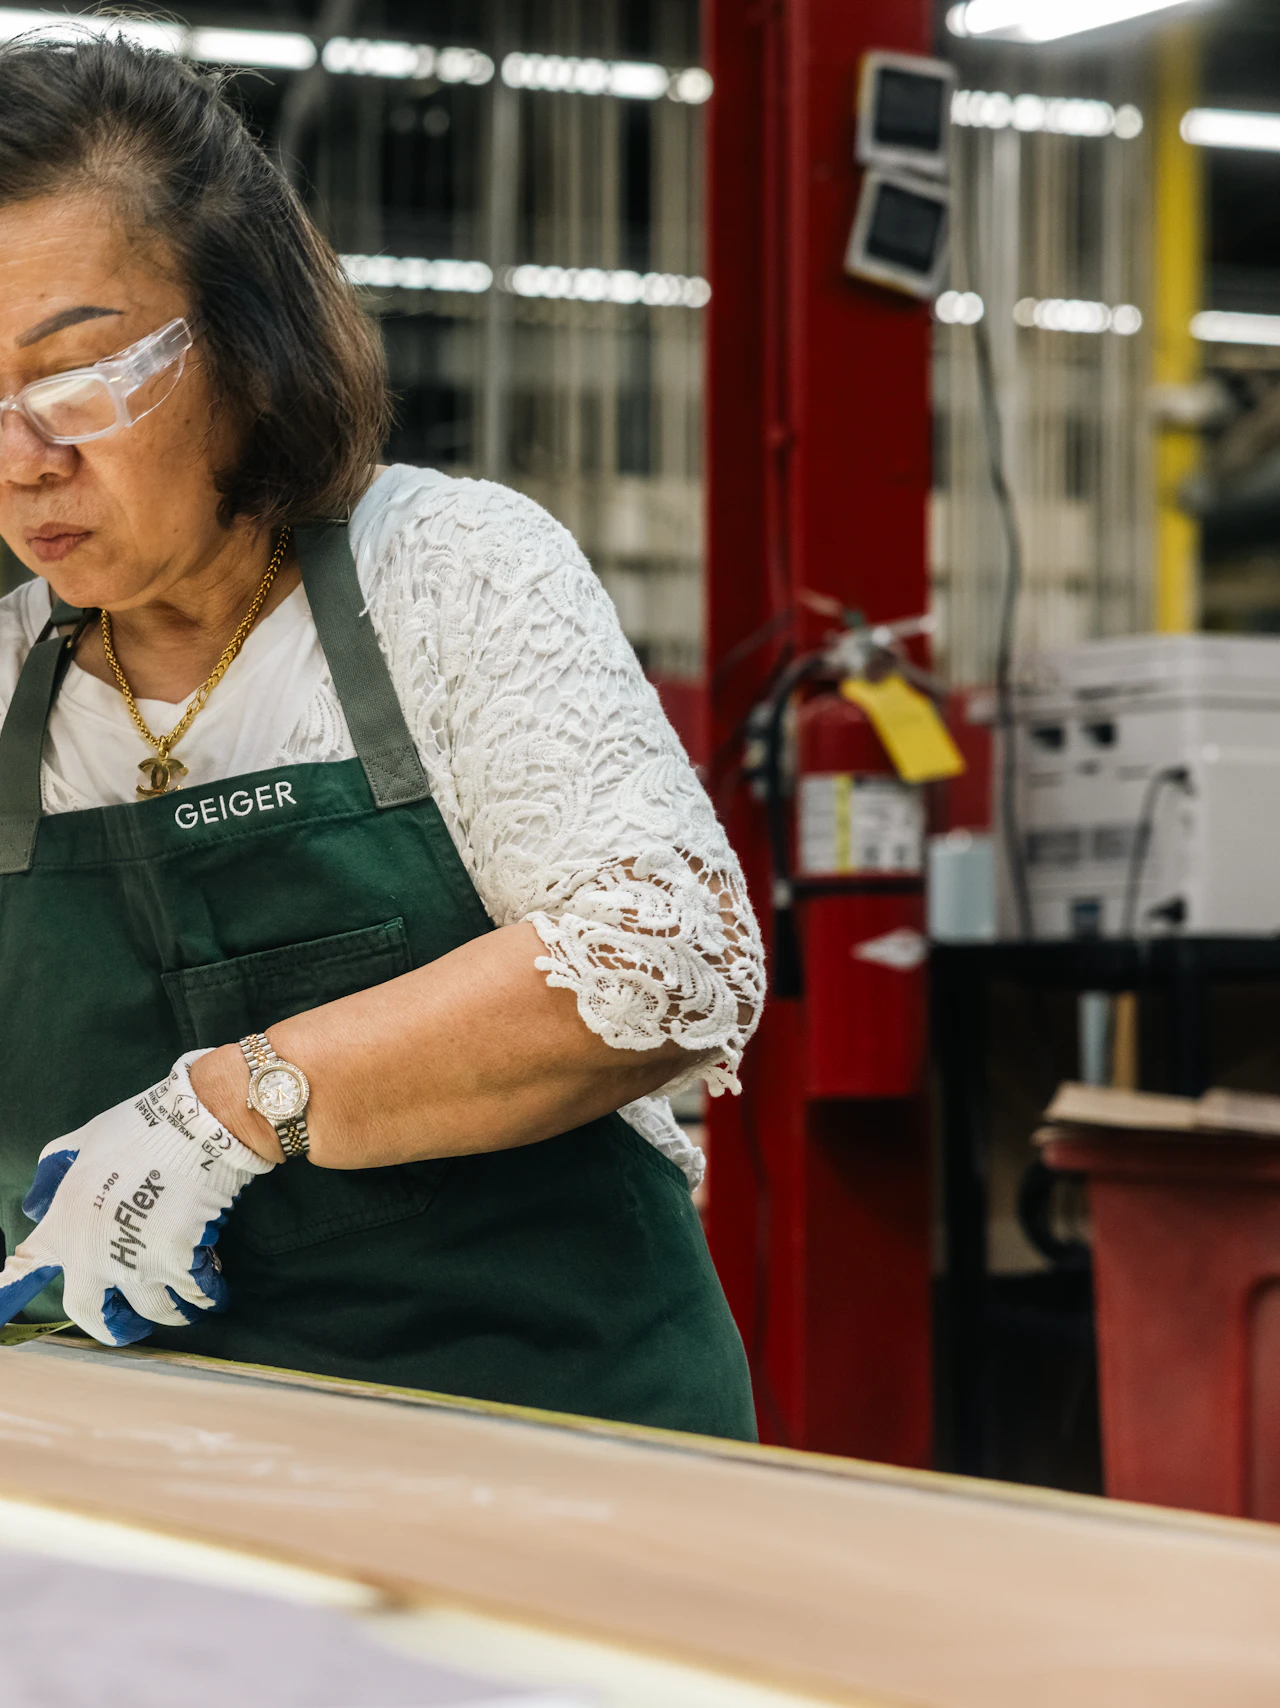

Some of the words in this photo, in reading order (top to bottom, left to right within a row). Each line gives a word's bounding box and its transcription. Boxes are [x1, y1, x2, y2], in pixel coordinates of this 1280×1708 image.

[174, 780, 298, 829] GEIGER
[134, 1098, 160, 1128] Ansell
[93, 1172, 120, 1211] 11-900
